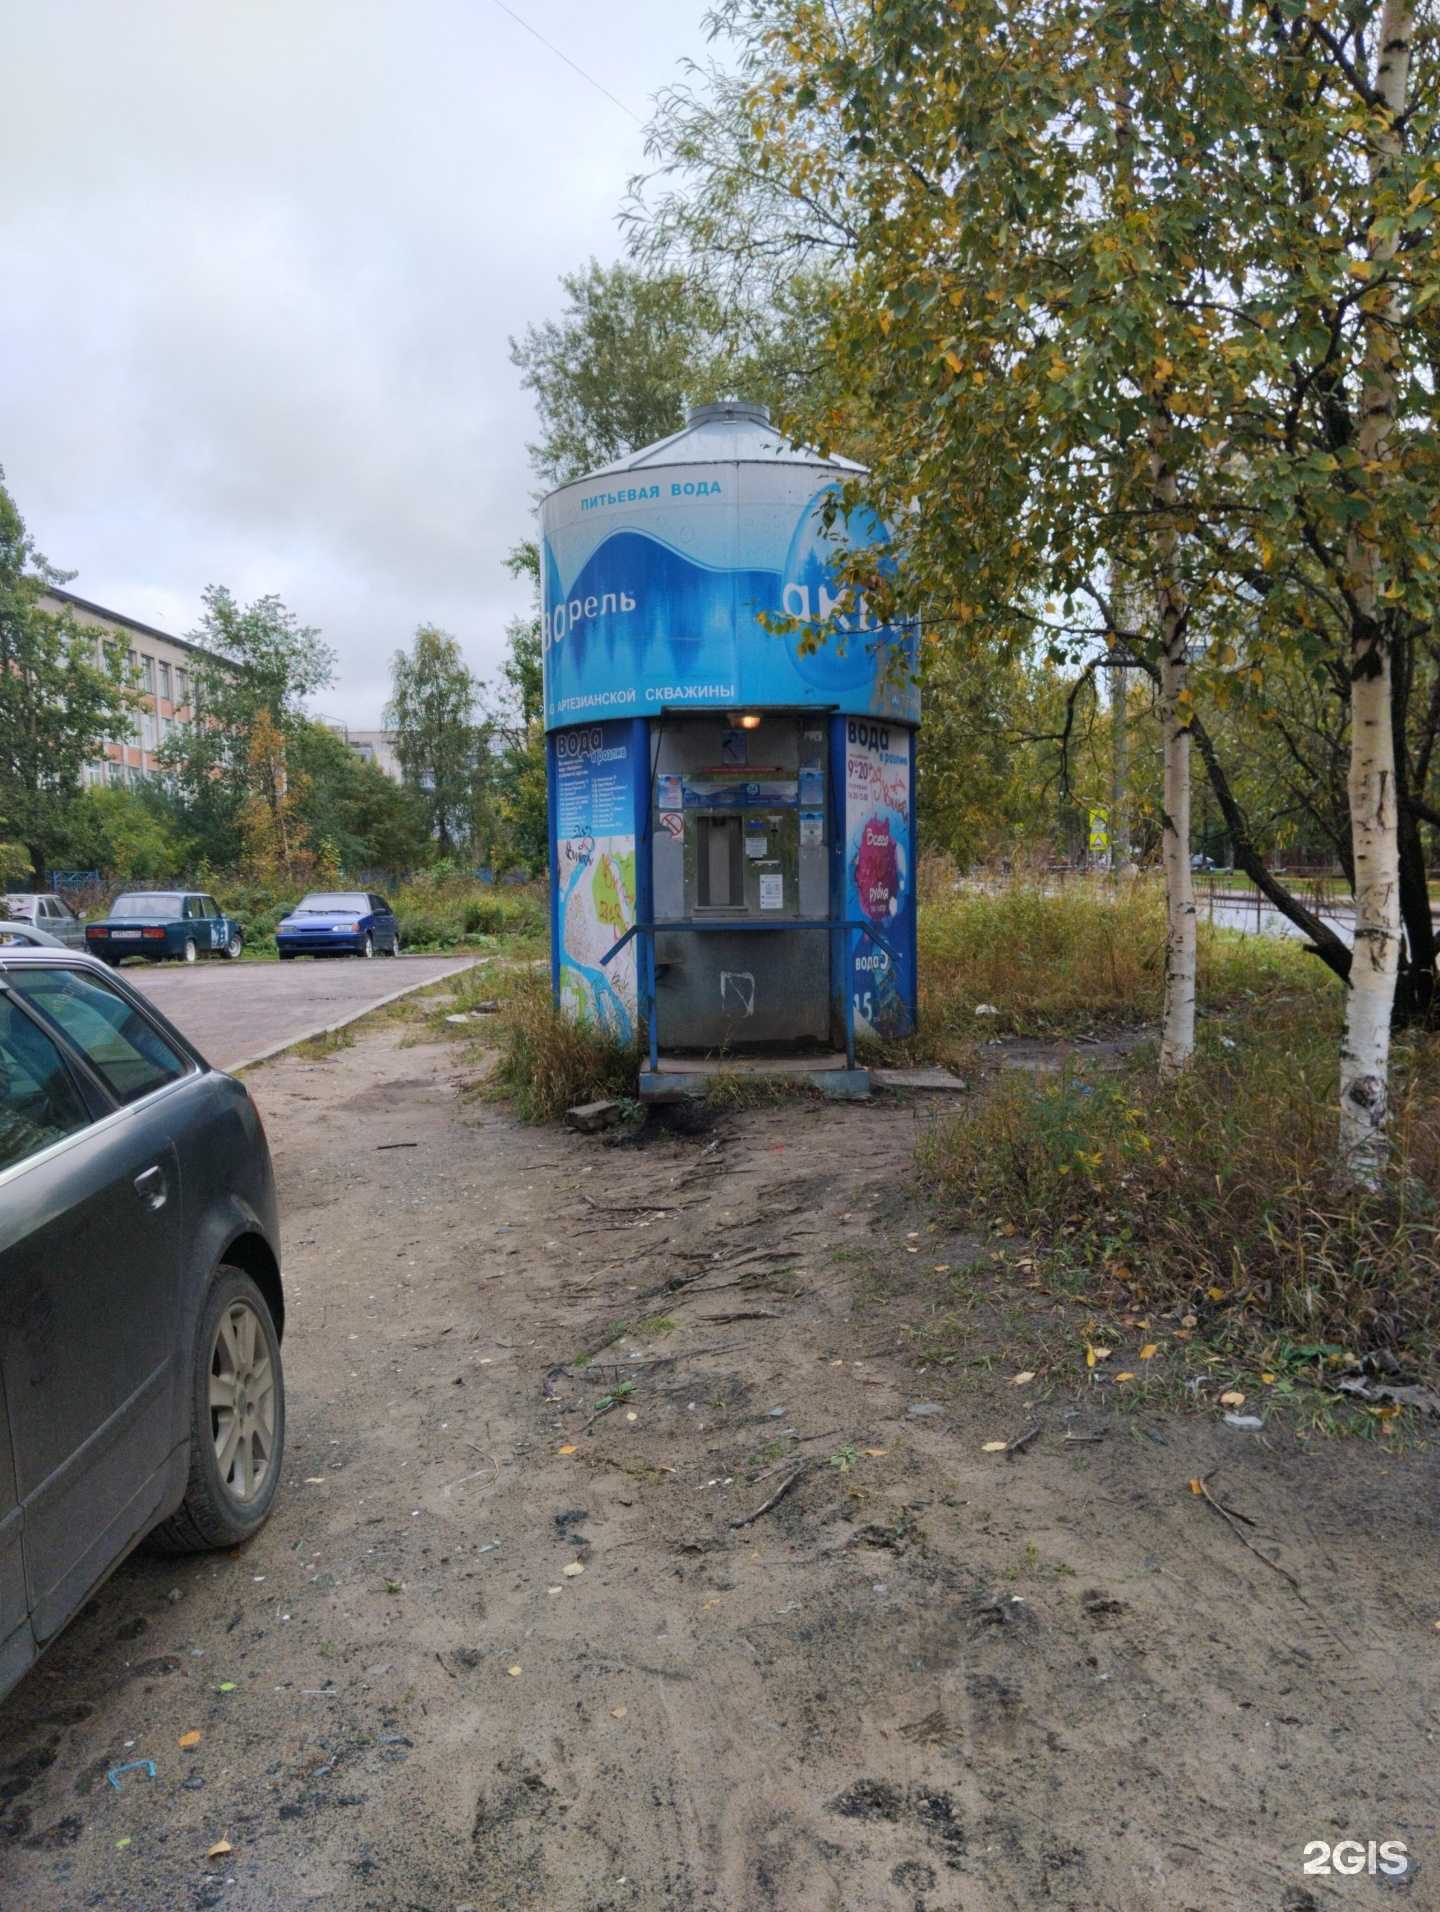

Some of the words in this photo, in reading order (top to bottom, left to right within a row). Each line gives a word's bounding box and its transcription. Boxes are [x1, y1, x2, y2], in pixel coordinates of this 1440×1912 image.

[581, 485, 660, 512] ПИТЬЕВАЯ
[671, 481, 721, 497] ВОДА
[645, 685, 735, 701] СКВАЖИНЫ
